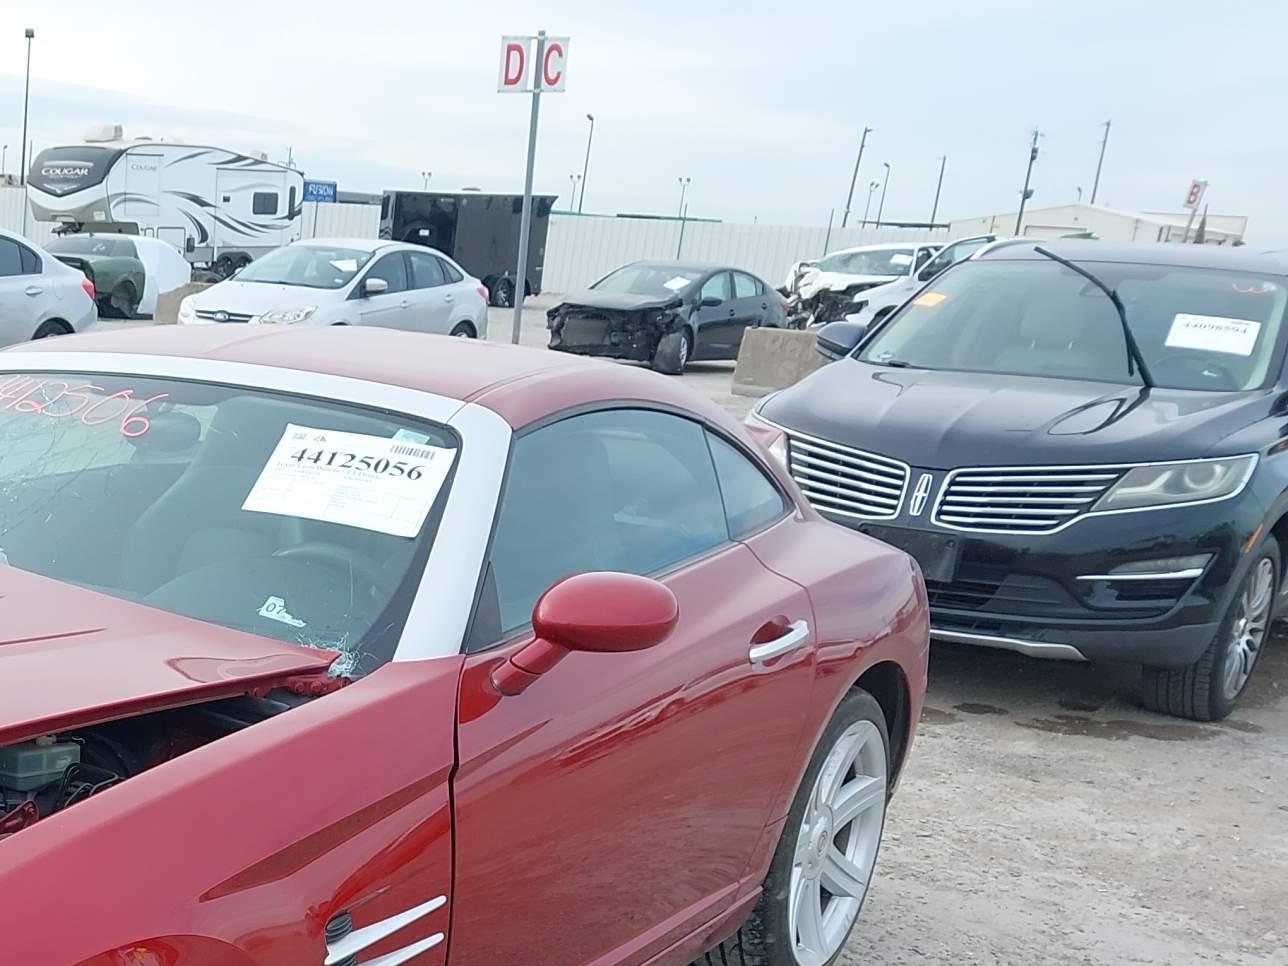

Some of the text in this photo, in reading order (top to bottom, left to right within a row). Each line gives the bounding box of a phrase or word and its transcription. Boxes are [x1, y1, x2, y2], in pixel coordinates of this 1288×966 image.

[504, 43, 524, 85] D
[543, 43, 563, 86] C
[41, 167, 89, 176] COUGAR
[1187, 183, 1201, 204] B
[290, 447, 425, 481] 44125056
